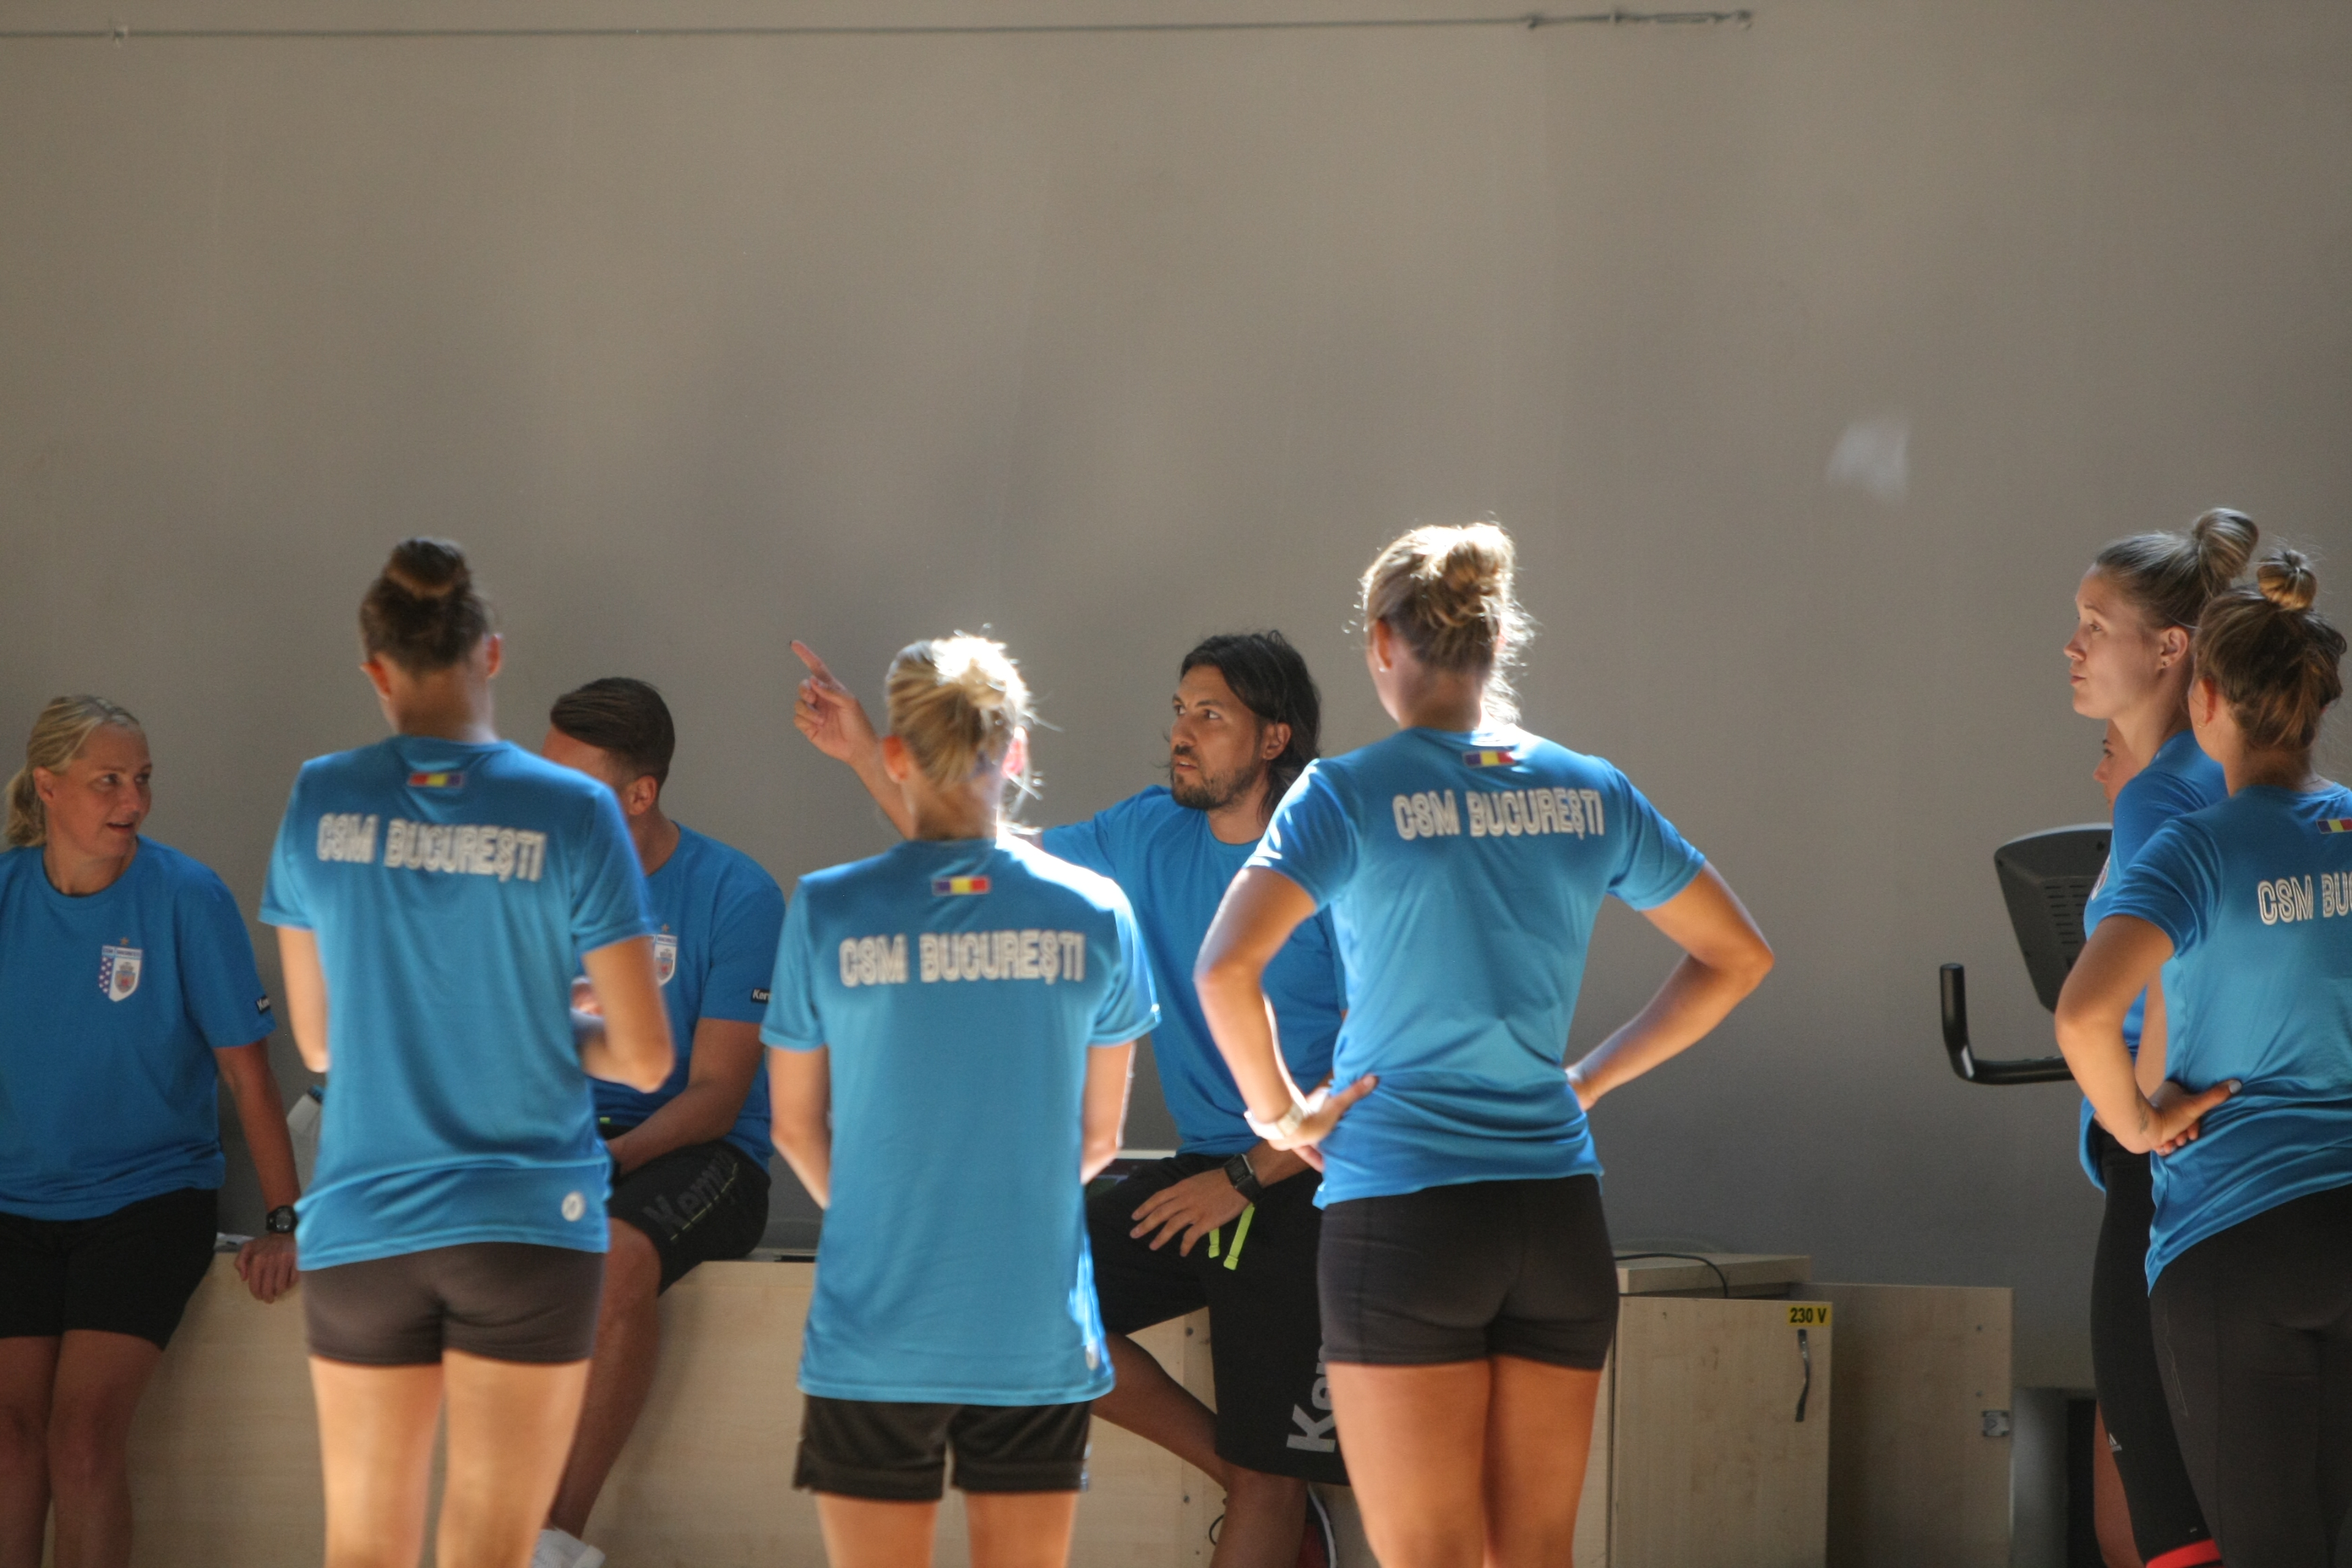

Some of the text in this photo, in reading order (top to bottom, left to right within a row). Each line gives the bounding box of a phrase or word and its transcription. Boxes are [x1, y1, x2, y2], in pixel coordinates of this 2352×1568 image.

[316, 813, 379, 864] CSM
[1392, 789, 1460, 840] CSM
[2257, 872, 2352, 926] CSM BU
[839, 932, 909, 987] CSM
[1789, 1307, 1827, 1324] 230 V
